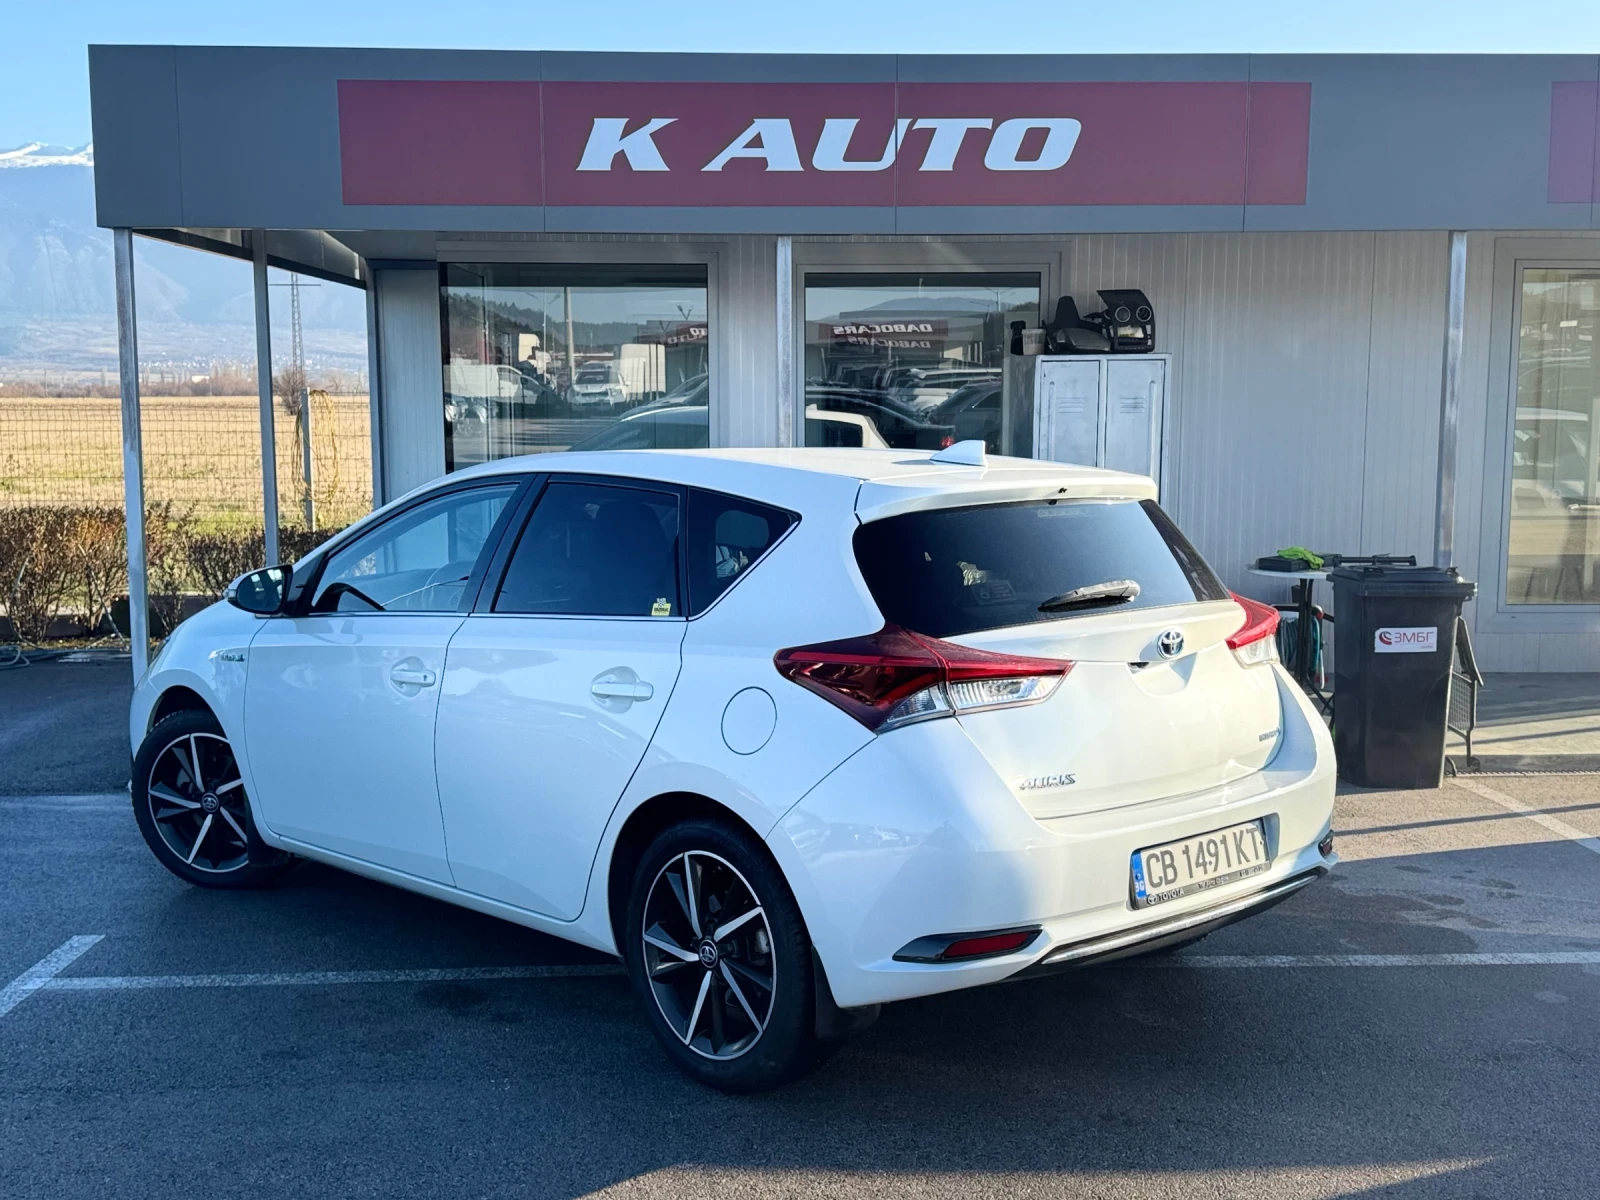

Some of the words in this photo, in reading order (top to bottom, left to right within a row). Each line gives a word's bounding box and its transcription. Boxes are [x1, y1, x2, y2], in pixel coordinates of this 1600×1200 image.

[576, 117, 680, 171] K
[700, 117, 1082, 171] AUTO
[1394, 631, 1434, 643] ЗМБГ
[1020, 773, 1075, 790] AURIS
[1146, 849, 1178, 888] CB
[1182, 834, 1231, 878] 1491
[1233, 828, 1260, 865] KT
[1160, 887, 1185, 901] TOYOTA
